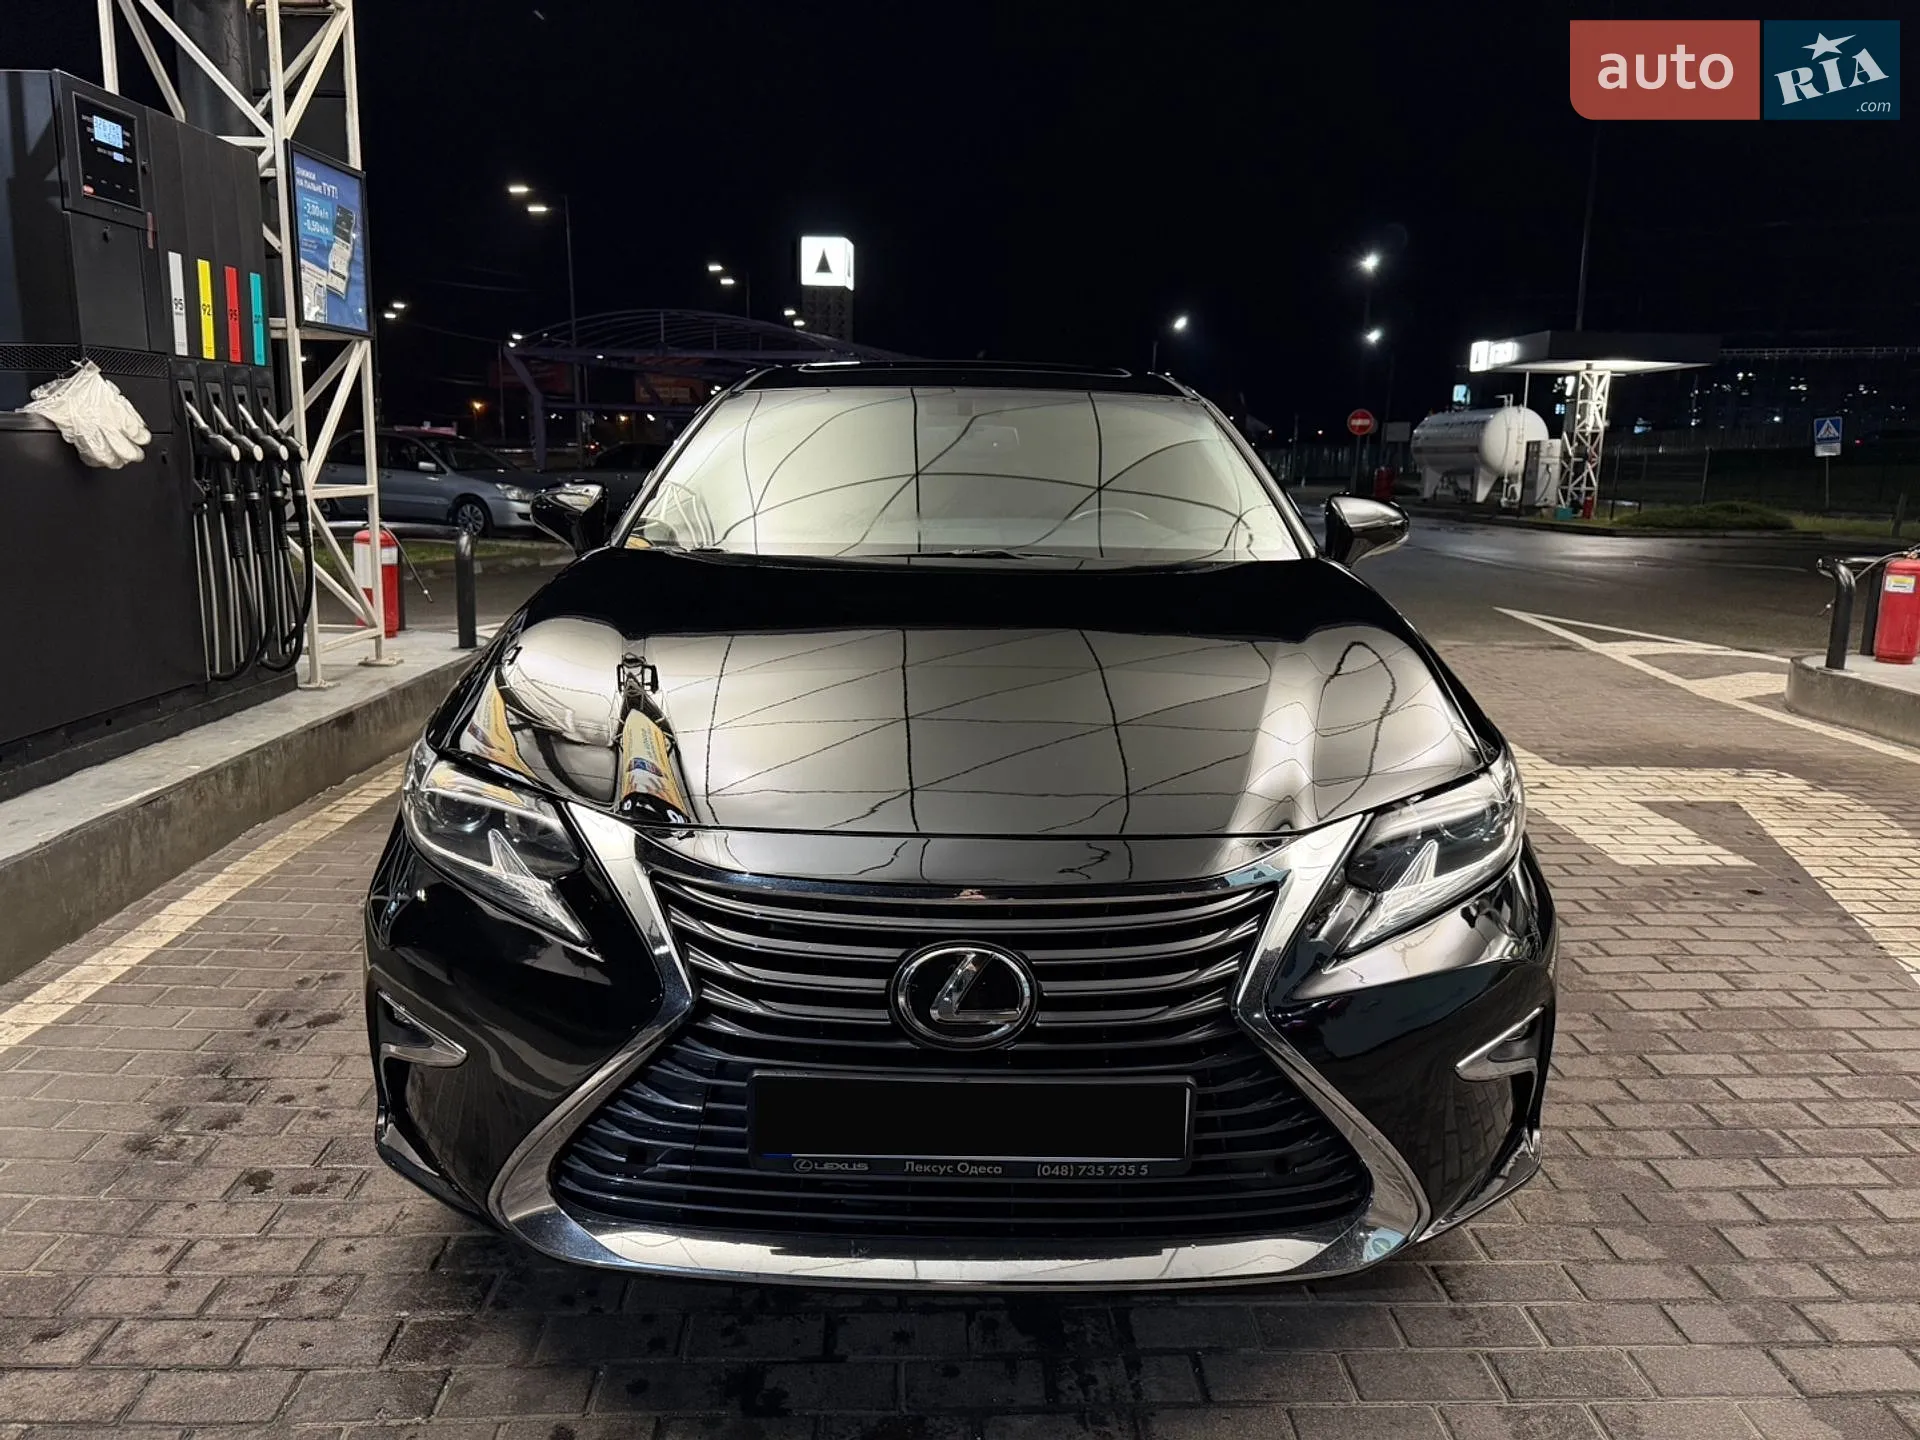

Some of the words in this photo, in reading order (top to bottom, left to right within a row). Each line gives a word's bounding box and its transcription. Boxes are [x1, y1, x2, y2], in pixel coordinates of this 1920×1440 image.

[202, 303, 212, 316] 92
[813, 1161, 870, 1171] LEXUS
[903, 1160, 954, 1175] Лексус
[957, 1162, 1002, 1175] Одеса
[1036, 1163, 1074, 1177] (048)
[1078, 1164, 1105, 1176] 735
[1108, 1164, 1136, 1176] 735
[1139, 1164, 1149, 1176] 5
